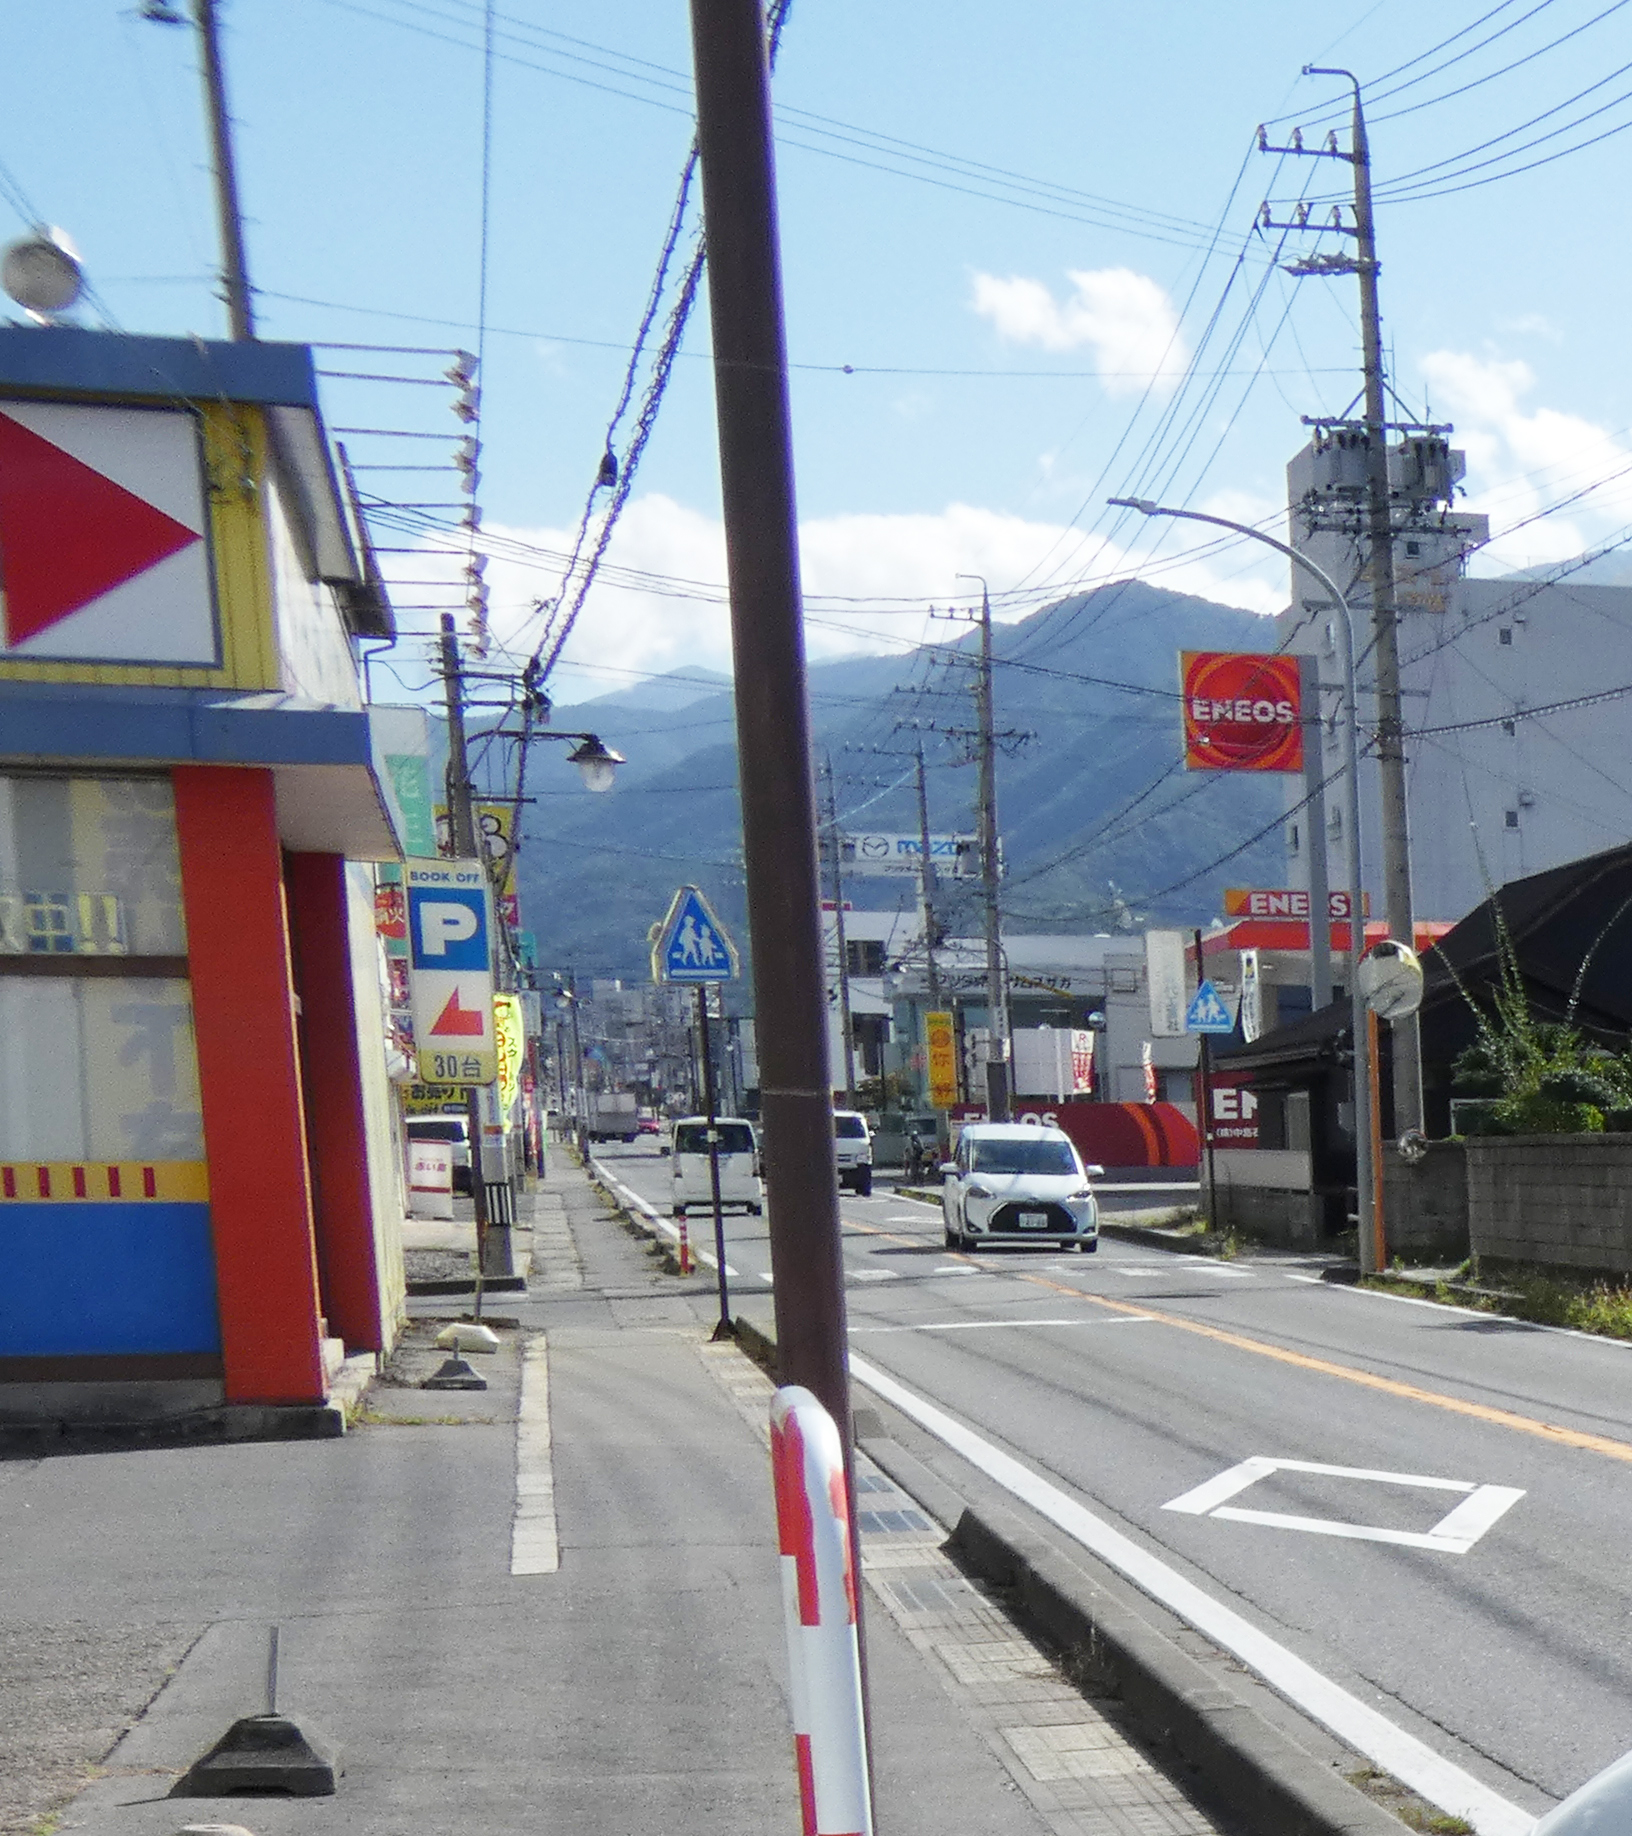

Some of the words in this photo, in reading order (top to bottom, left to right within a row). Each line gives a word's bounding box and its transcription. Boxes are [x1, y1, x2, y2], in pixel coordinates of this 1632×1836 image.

[1193, 699, 1293, 723] ENEOS
[410, 871, 450, 882] BOOK
[456, 872, 480, 882] OFF
[1250, 893, 1348, 916] ENES
[420, 902, 478, 955] P
[434, 1055, 482, 1078] 30台
